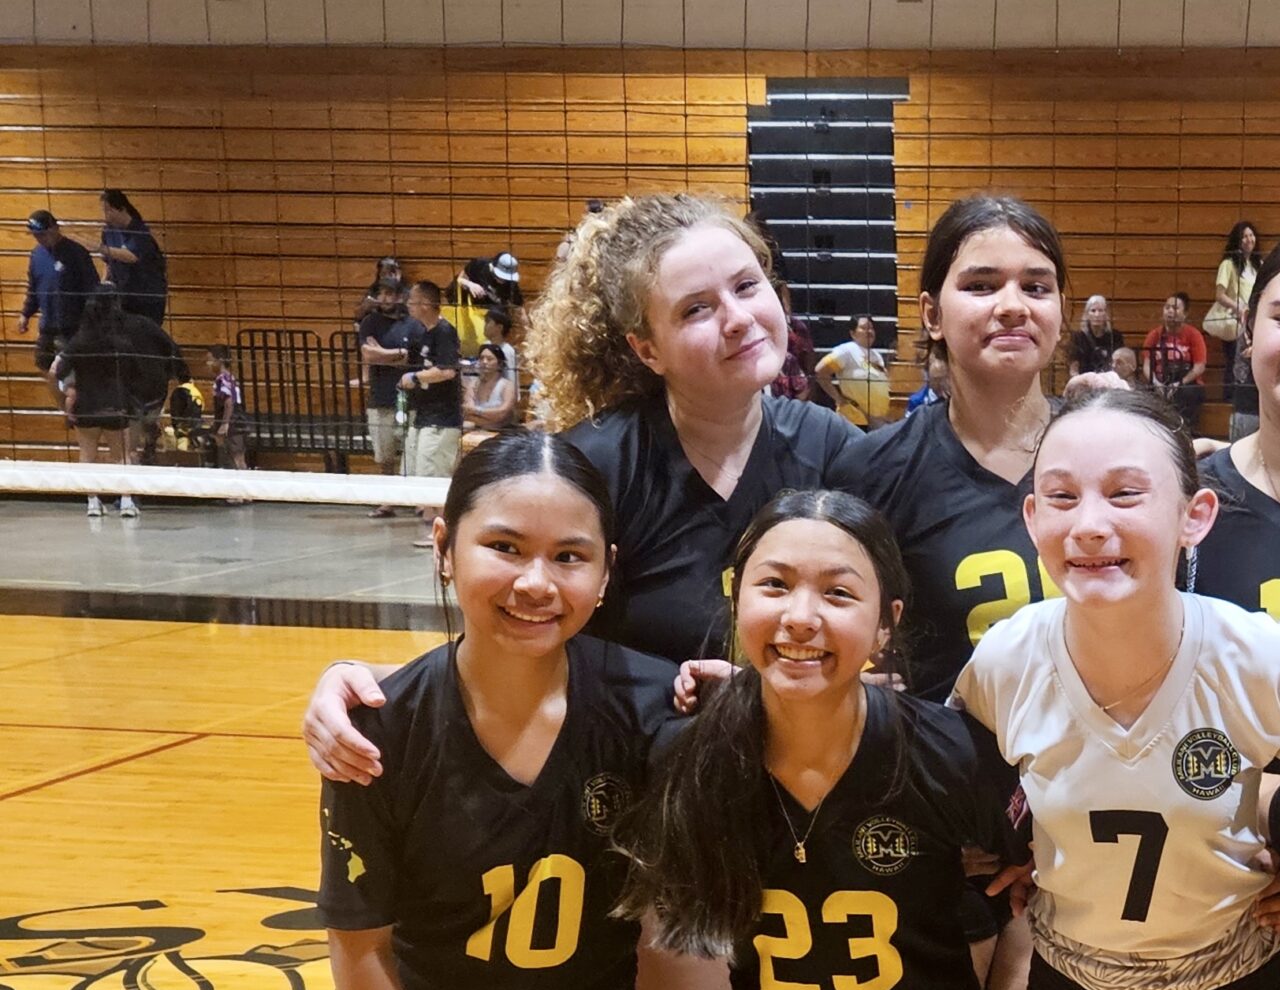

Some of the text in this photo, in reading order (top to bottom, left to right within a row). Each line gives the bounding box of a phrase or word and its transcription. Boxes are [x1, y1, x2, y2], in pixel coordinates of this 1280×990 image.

[955, 549, 1065, 649] 2
[1185, 746, 1230, 782] M
[1188, 731, 1235, 752] VOLLEYBALL
[1192, 785, 1226, 797] HAWAII
[1088, 809, 1170, 923] 7
[465, 853, 586, 970] 10
